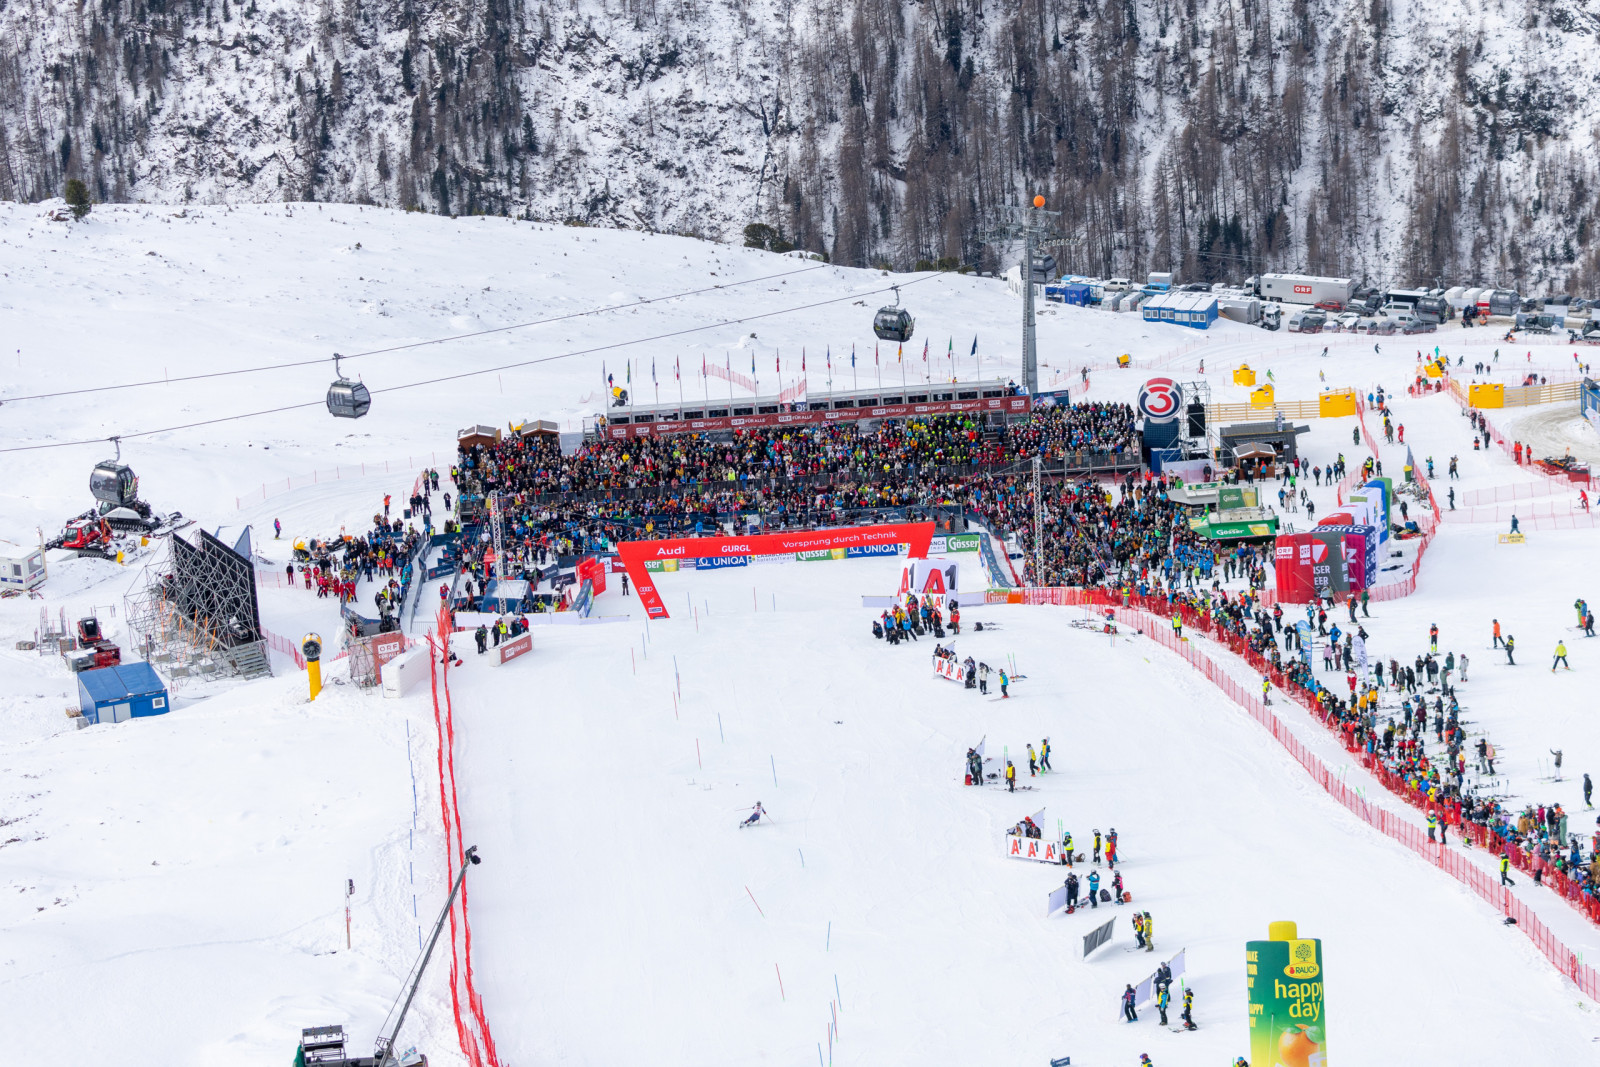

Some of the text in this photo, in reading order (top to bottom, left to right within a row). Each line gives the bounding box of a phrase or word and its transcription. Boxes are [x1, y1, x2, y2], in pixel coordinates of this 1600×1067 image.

[783, 532, 897, 548] Vorsprung durch Technik
[949, 537, 979, 550] Gösser
[657, 547, 685, 555] Audi
[864, 544, 896, 554] UNIQA
[713, 556, 745, 566] UNIQA
[922, 564, 956, 594] A1
[379, 643, 398, 652] ORF
[1011, 838, 1056, 859] A1 A1 A1
[1289, 999, 1320, 1022] day
